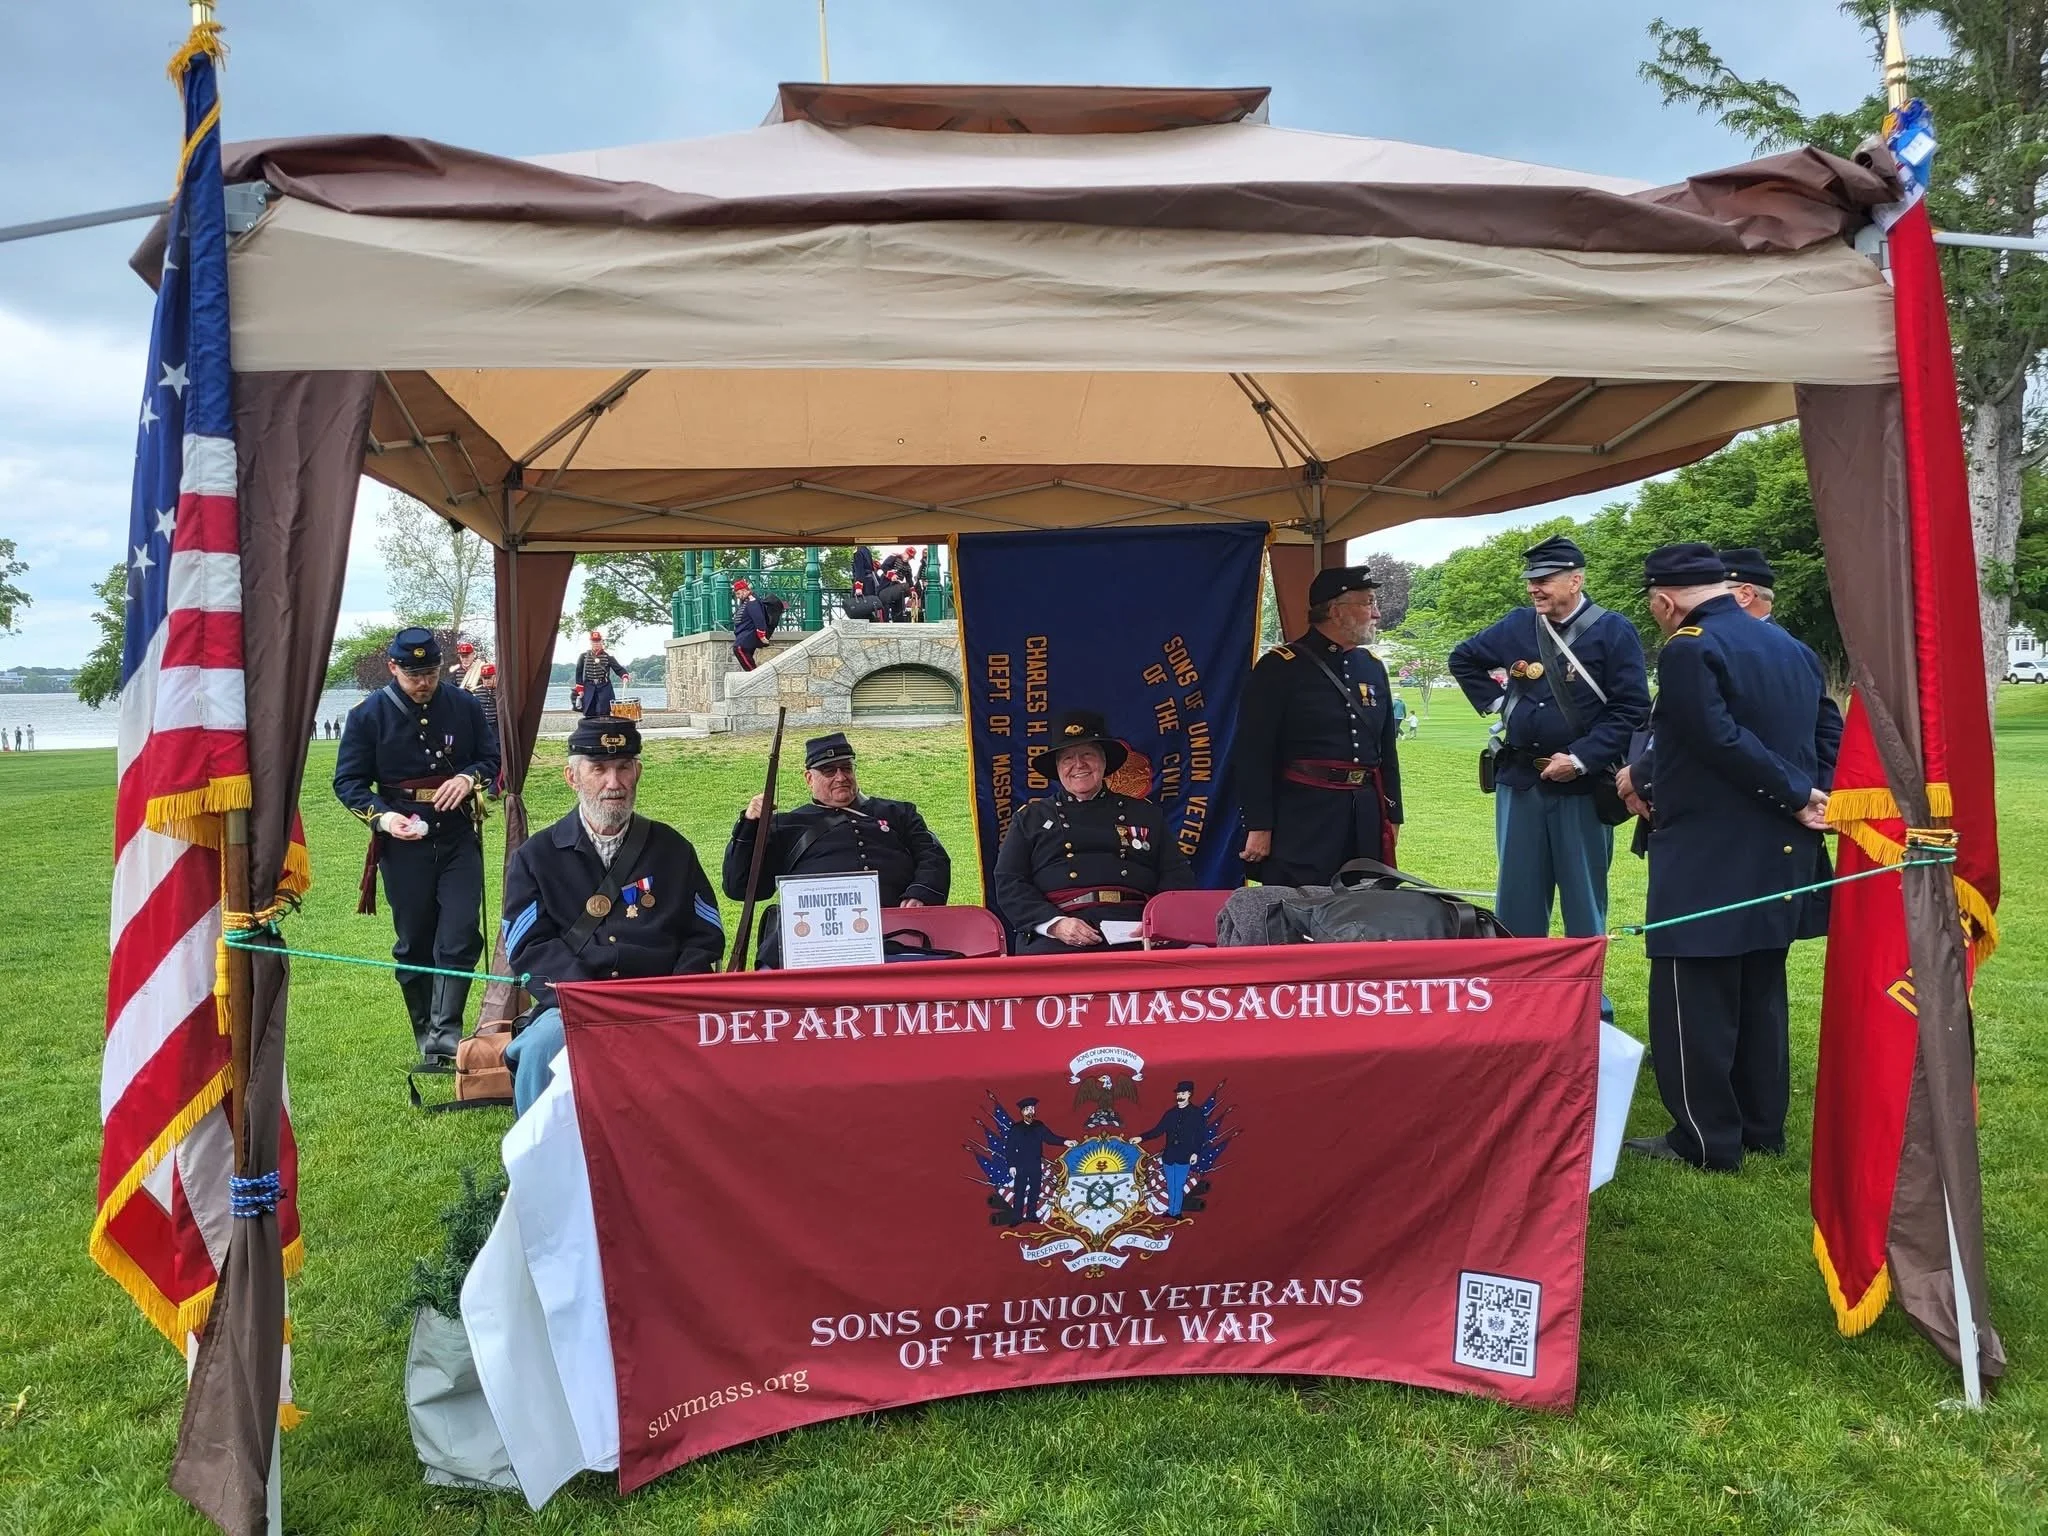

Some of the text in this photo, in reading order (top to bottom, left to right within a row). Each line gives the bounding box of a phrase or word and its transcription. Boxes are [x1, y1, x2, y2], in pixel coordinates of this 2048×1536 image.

[987, 653, 1011, 703] DEPT.
[1026, 635, 1048, 713] CHARLES
[988, 715, 1011, 737] OF
[1026, 720, 1048, 737] H.
[1142, 663, 1181, 803] OF THE CIVIL
[1163, 635, 1212, 856] SONS OF UNION VETER
[1027, 745, 1049, 789] BND
[798, 891, 862, 908] MINUTEMEN
[824, 907, 837, 921] OF
[820, 921, 844, 937] 1861
[697, 977, 1493, 1048] DEPARTMENT OF MASSACHUSETTS
[1076, 1053, 1090, 1063] SONS
[1089, 1049, 1097, 1057] OF
[1114, 1048, 1137, 1061] VETERANS
[1026, 1241, 1070, 1259] PRESERVED
[1126, 1236, 1164, 1249] OF GOD
[1071, 1255, 1121, 1269] BY THE GRACE
[810, 1278, 1364, 1347] SONS OF UNION VETERANS
[899, 1308, 1278, 1370] OF THE CIVIL WAR
[647, 1369, 810, 1439] suvmass.org
